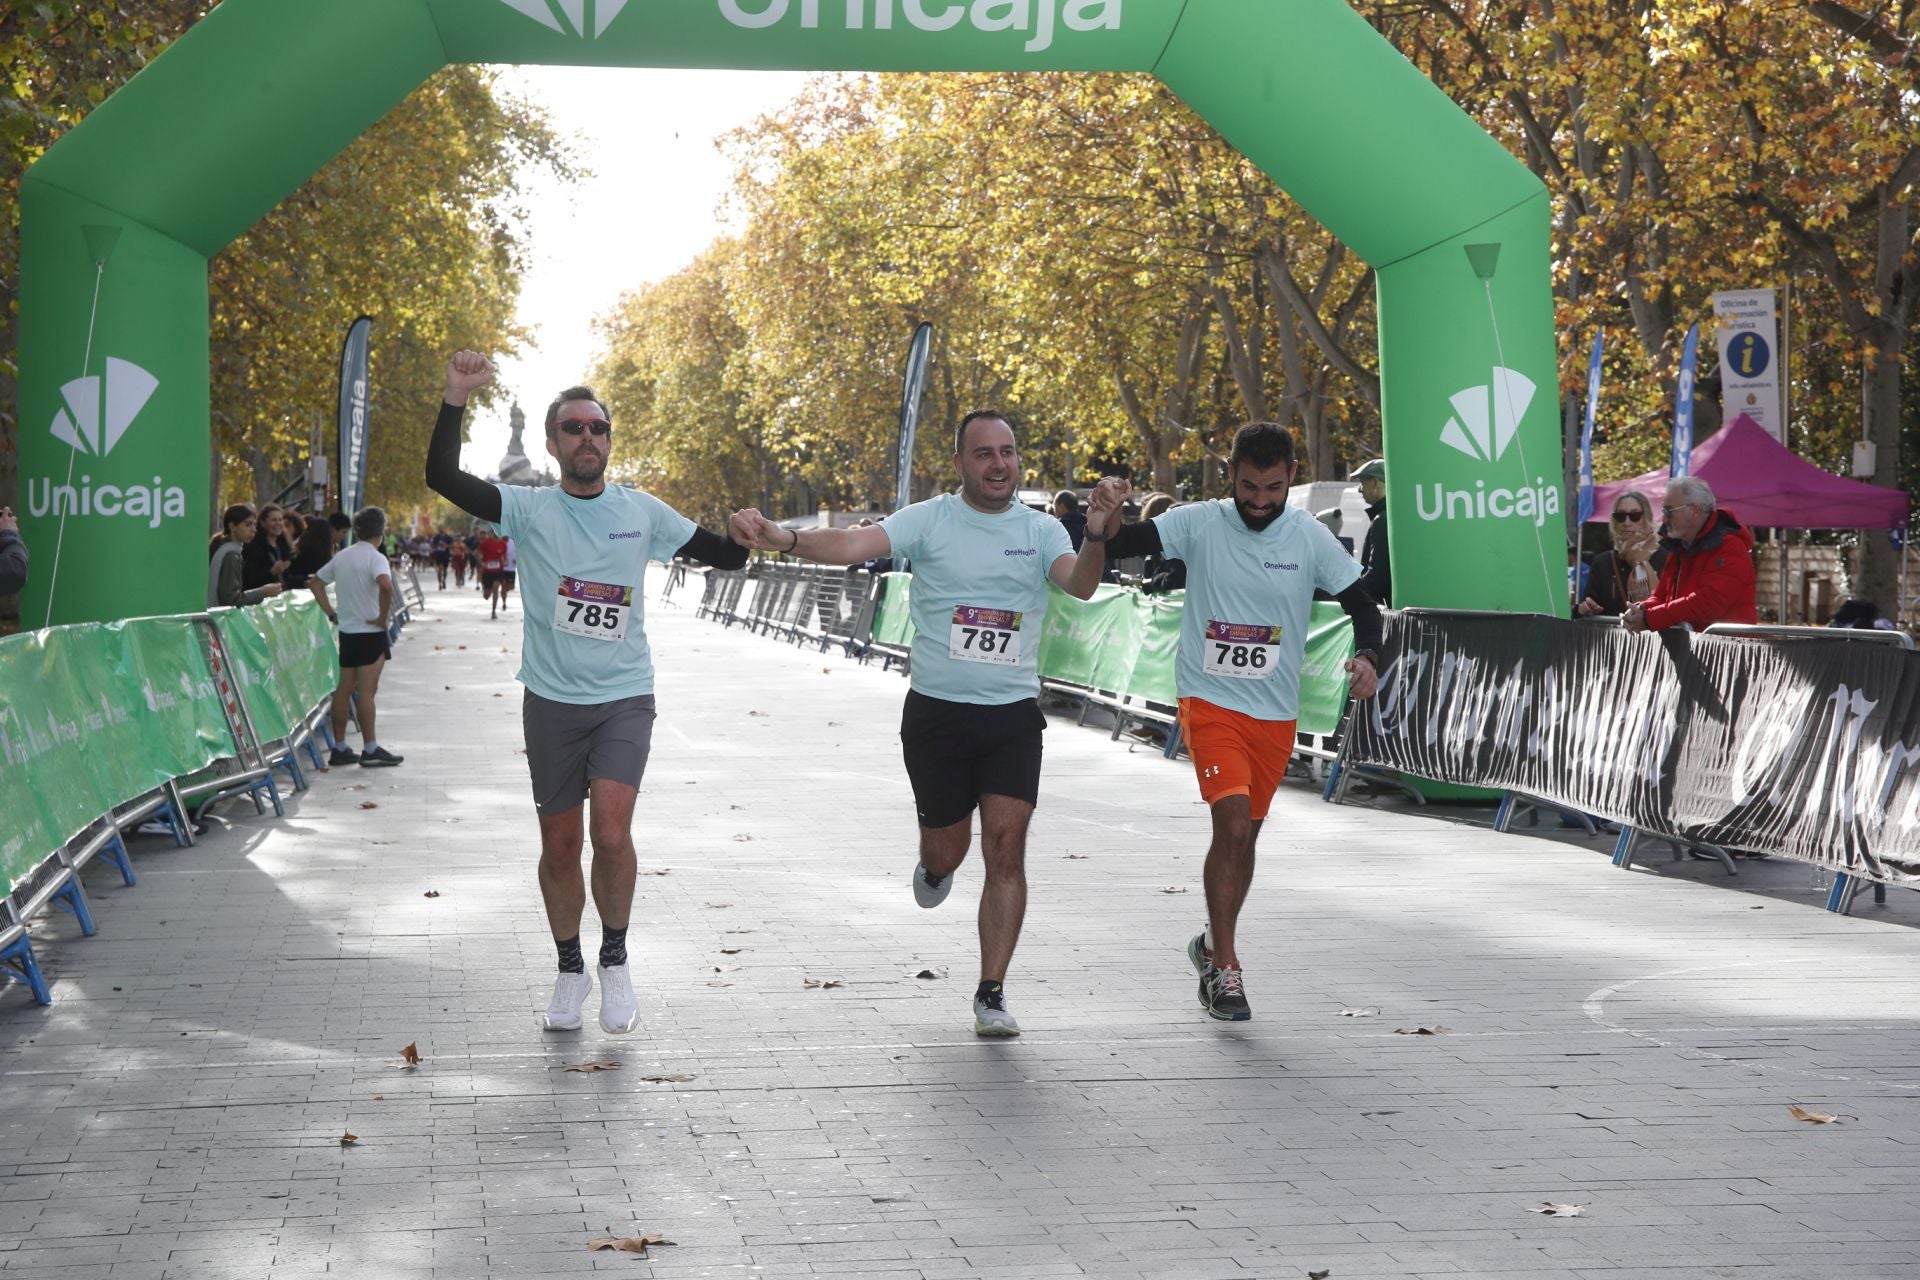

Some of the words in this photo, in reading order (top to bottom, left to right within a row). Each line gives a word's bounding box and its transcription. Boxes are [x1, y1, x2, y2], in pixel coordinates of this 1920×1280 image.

[1720, 300, 1747, 308] Oficina
[28, 474, 185, 528] Unicaja
[1415, 476, 1559, 527] Unicaja
[609, 531, 641, 540] OneHealth
[1004, 548, 1037, 556] OneHealth
[1264, 561, 1299, 571] OneHealth
[567, 600, 620, 630] 785
[962, 627, 1011, 654] 787
[1216, 643, 1267, 668] 786
